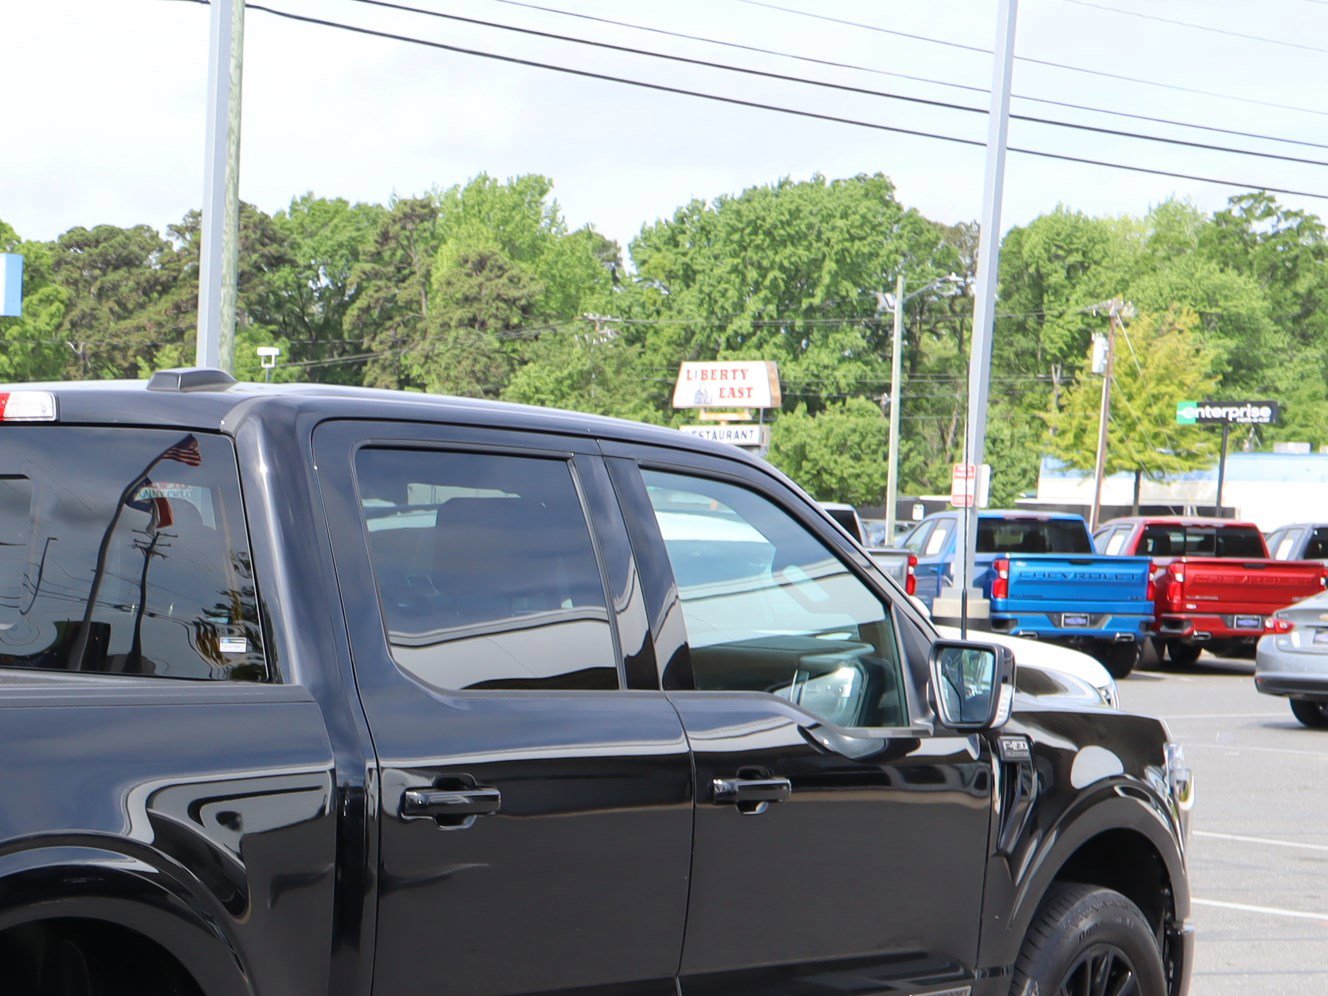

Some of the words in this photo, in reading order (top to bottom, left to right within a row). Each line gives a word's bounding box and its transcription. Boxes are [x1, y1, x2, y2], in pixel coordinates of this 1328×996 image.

[686, 368, 749, 381] LIBERTY
[719, 387, 753, 398] EAST
[1180, 403, 1272, 421] enterprise
